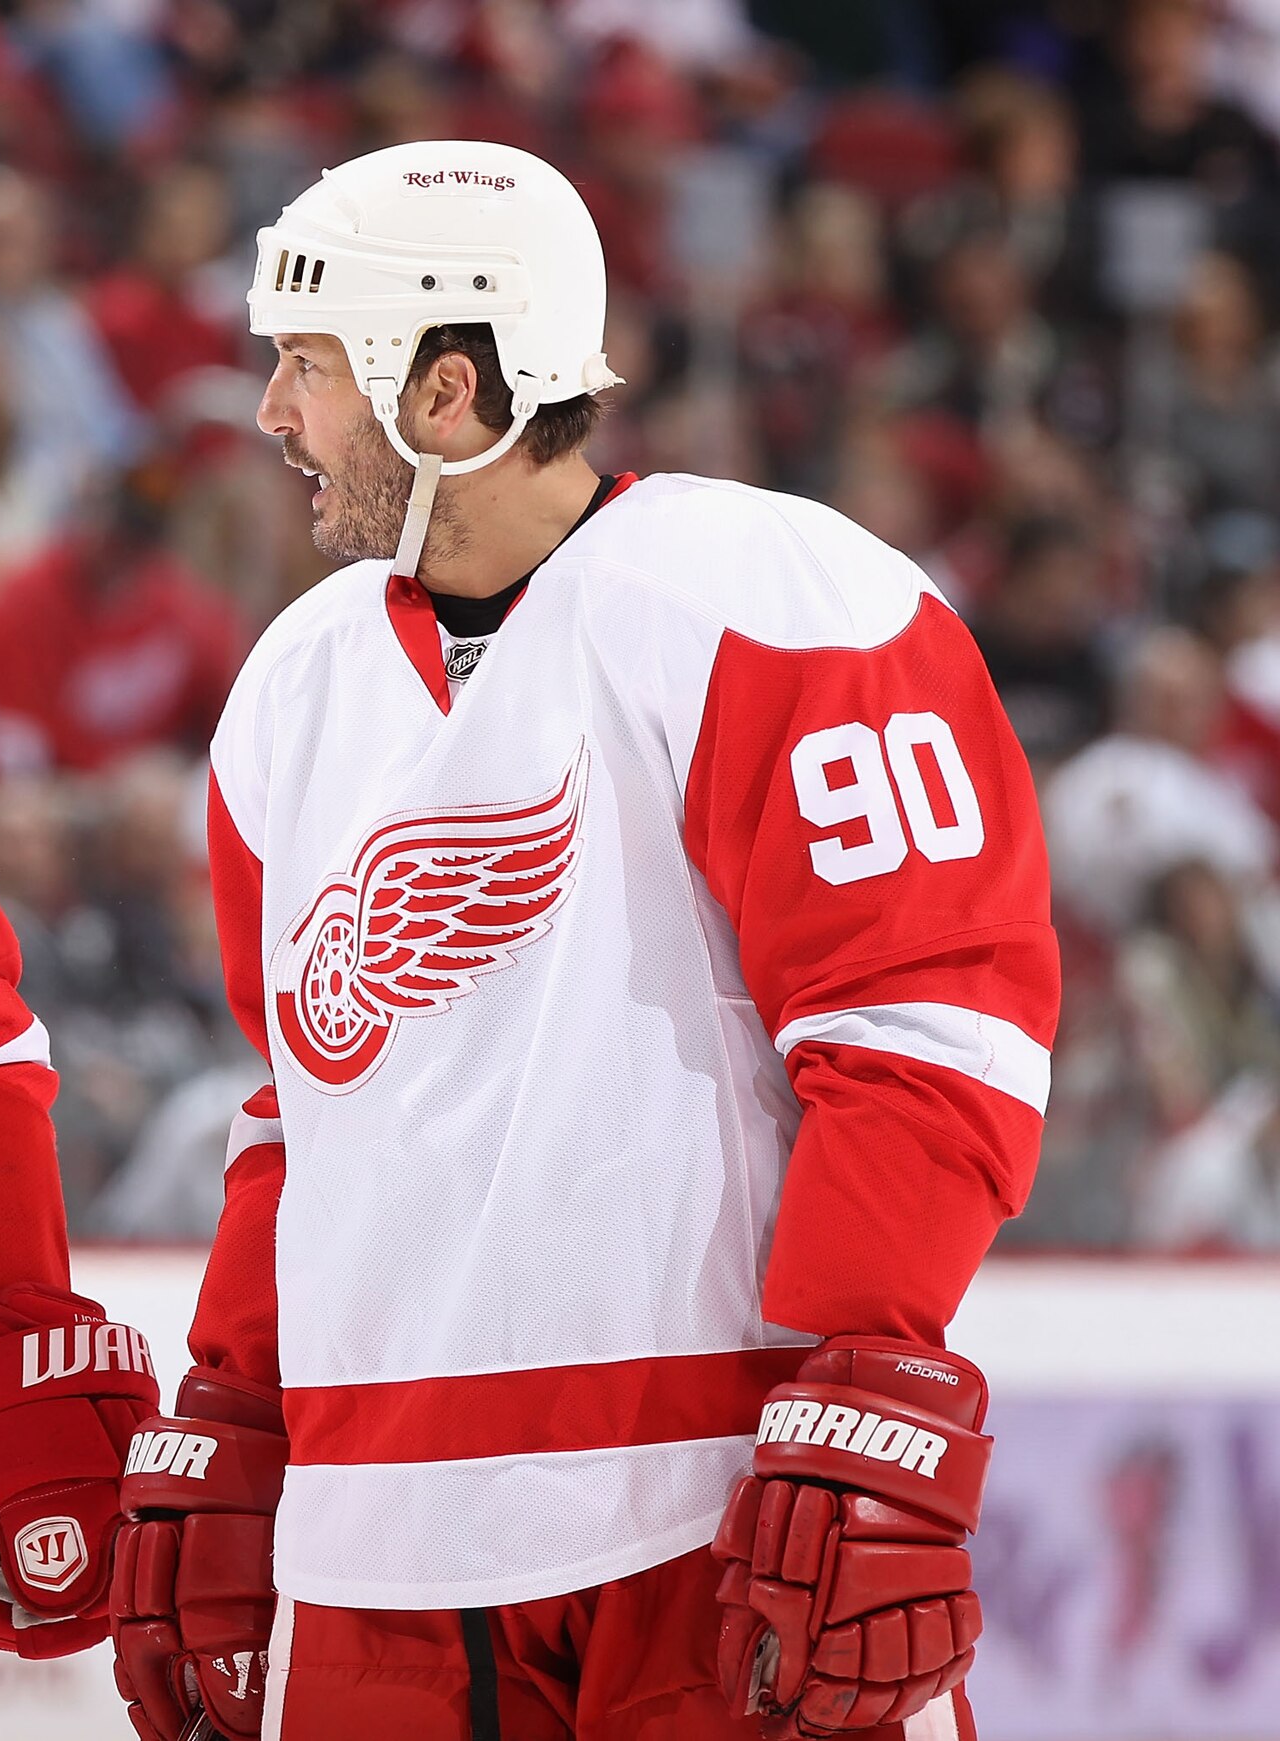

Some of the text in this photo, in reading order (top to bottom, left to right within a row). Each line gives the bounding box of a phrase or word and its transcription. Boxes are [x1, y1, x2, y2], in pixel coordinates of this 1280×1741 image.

[403, 171, 516, 191] Red Wings
[452, 651, 481, 674] NHL
[789, 711, 986, 887] 90
[895, 1361, 959, 1386] MODANO
[756, 1400, 949, 1480] ARRIOR
